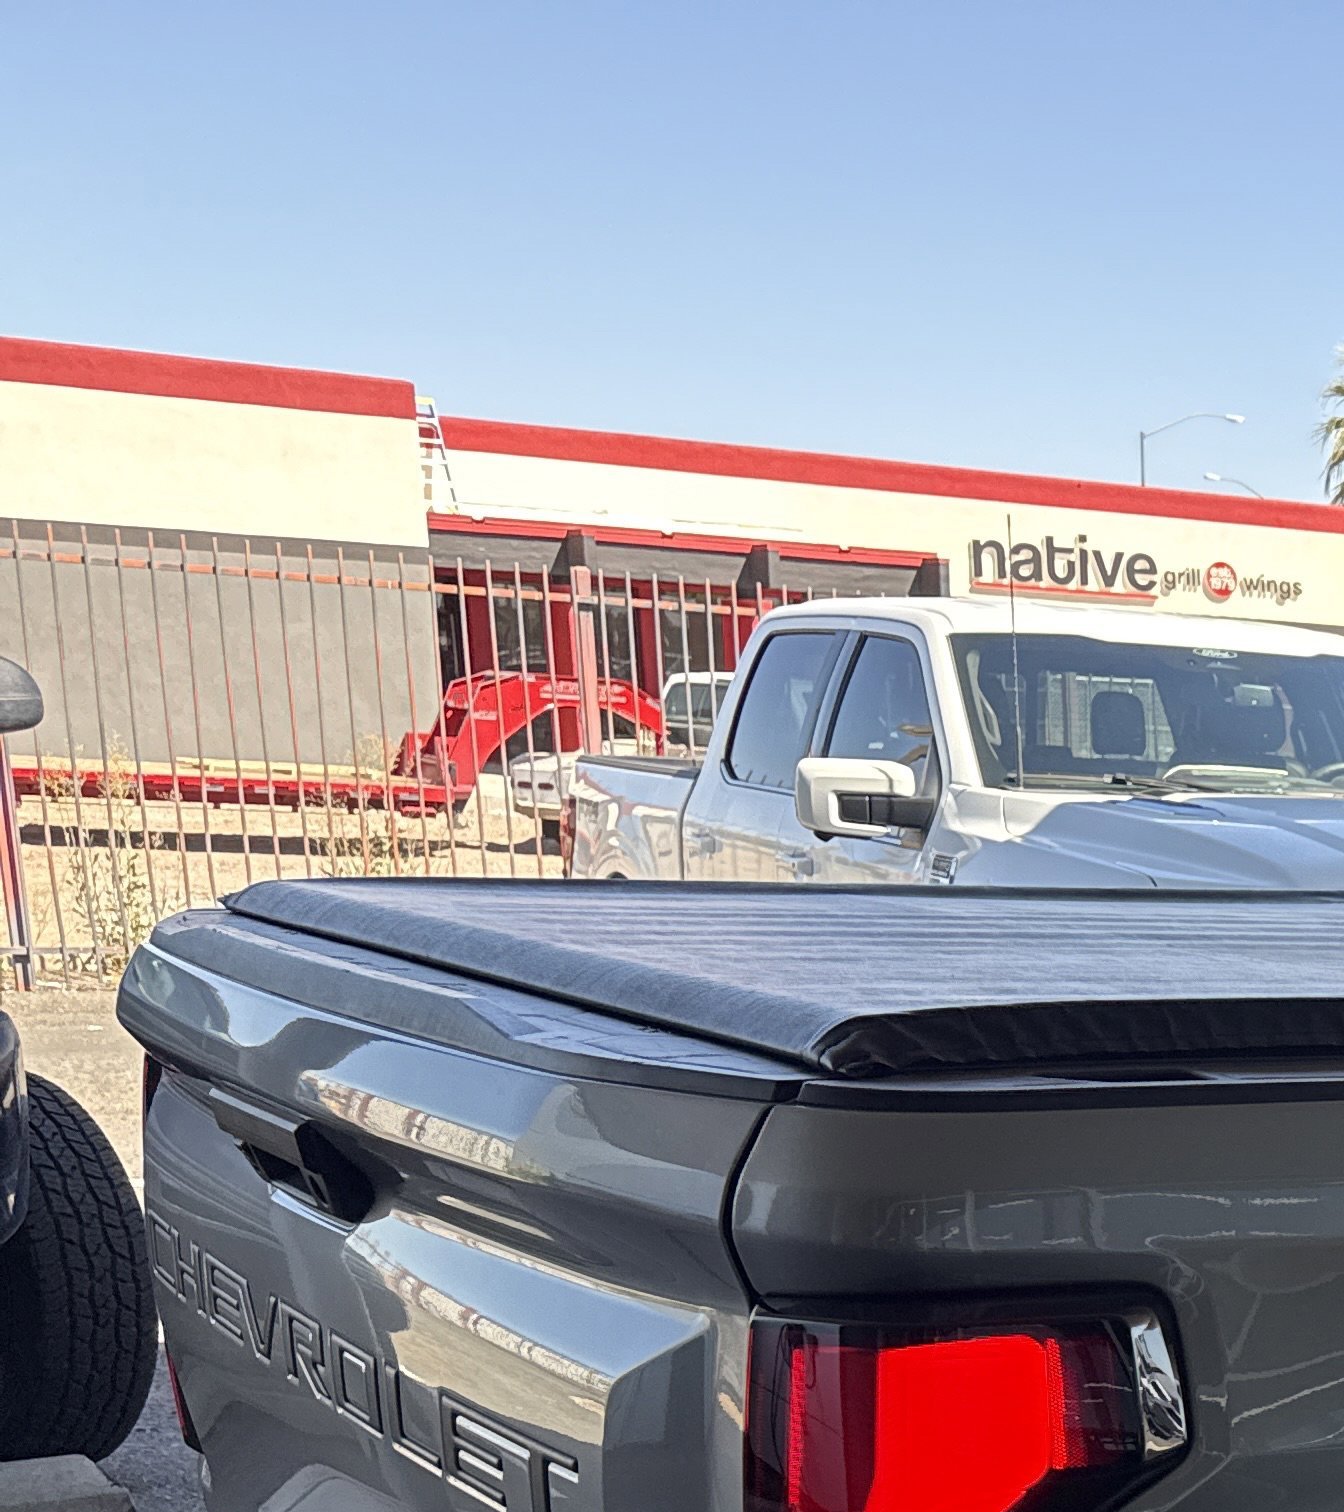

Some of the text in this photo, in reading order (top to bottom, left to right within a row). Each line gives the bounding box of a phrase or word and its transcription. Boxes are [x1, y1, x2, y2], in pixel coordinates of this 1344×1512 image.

[970, 534, 1303, 600] native grill wings
